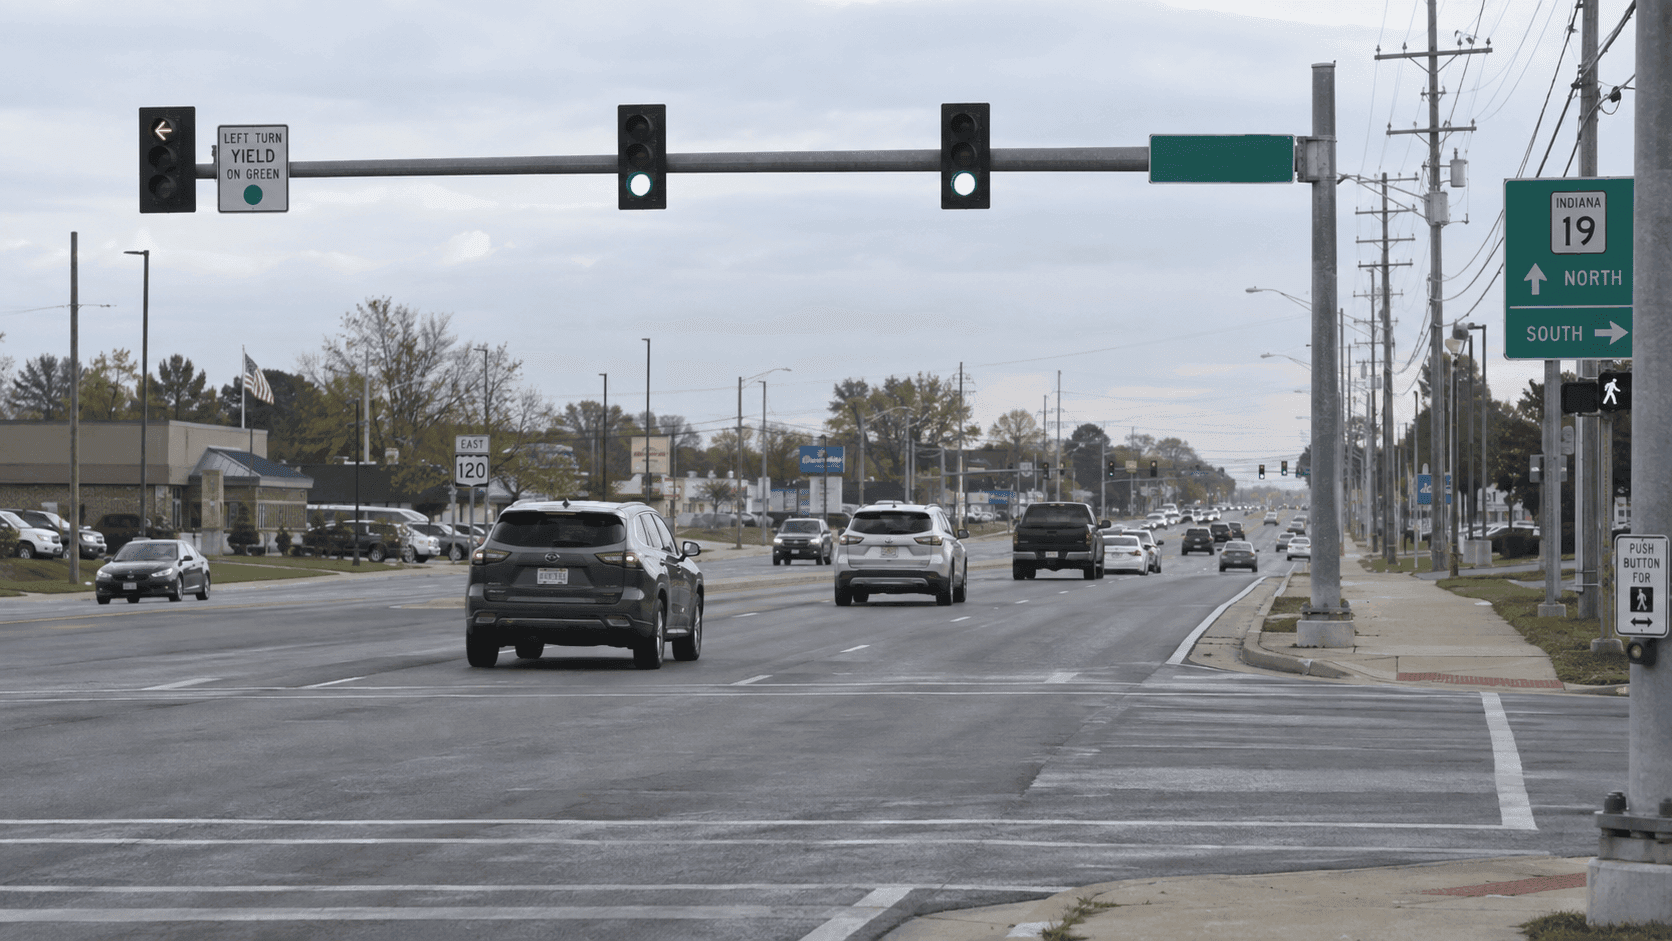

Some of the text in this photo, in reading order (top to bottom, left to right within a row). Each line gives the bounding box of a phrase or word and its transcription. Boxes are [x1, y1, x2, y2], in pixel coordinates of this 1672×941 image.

[224, 132, 282, 144] LEFT TURN
[231, 148, 276, 164] YIELD
[226, 168, 280, 180] ON GREEN
[1556, 197, 1602, 209] INDIANA
[1562, 216, 1596, 246] 19
[1564, 269, 1623, 287] NORTH
[1526, 325, 1583, 342] SOUTH
[460, 438, 484, 450] EAST
[458, 462, 486, 479] 120
[1629, 542, 1655, 554] PUSH
[1623, 557, 1661, 569] BUTTON
[1632, 572, 1651, 583] FOR
